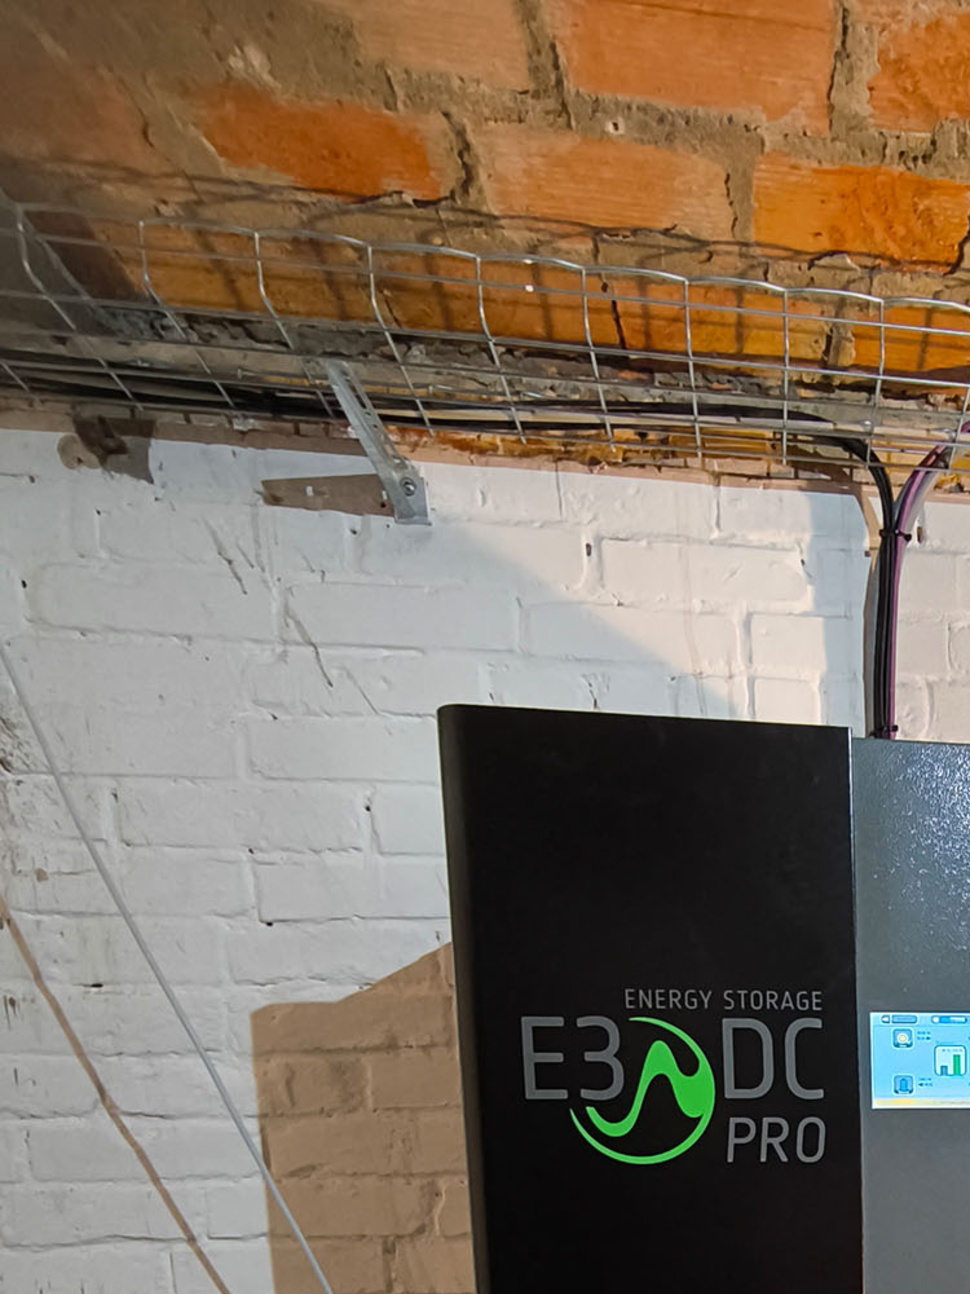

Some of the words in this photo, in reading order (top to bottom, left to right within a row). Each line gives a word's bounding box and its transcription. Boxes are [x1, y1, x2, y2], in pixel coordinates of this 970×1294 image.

[624, 988, 712, 1009] ENERGY
[723, 989, 823, 1011] STORAGE
[727, 1116, 826, 1163] PRO
